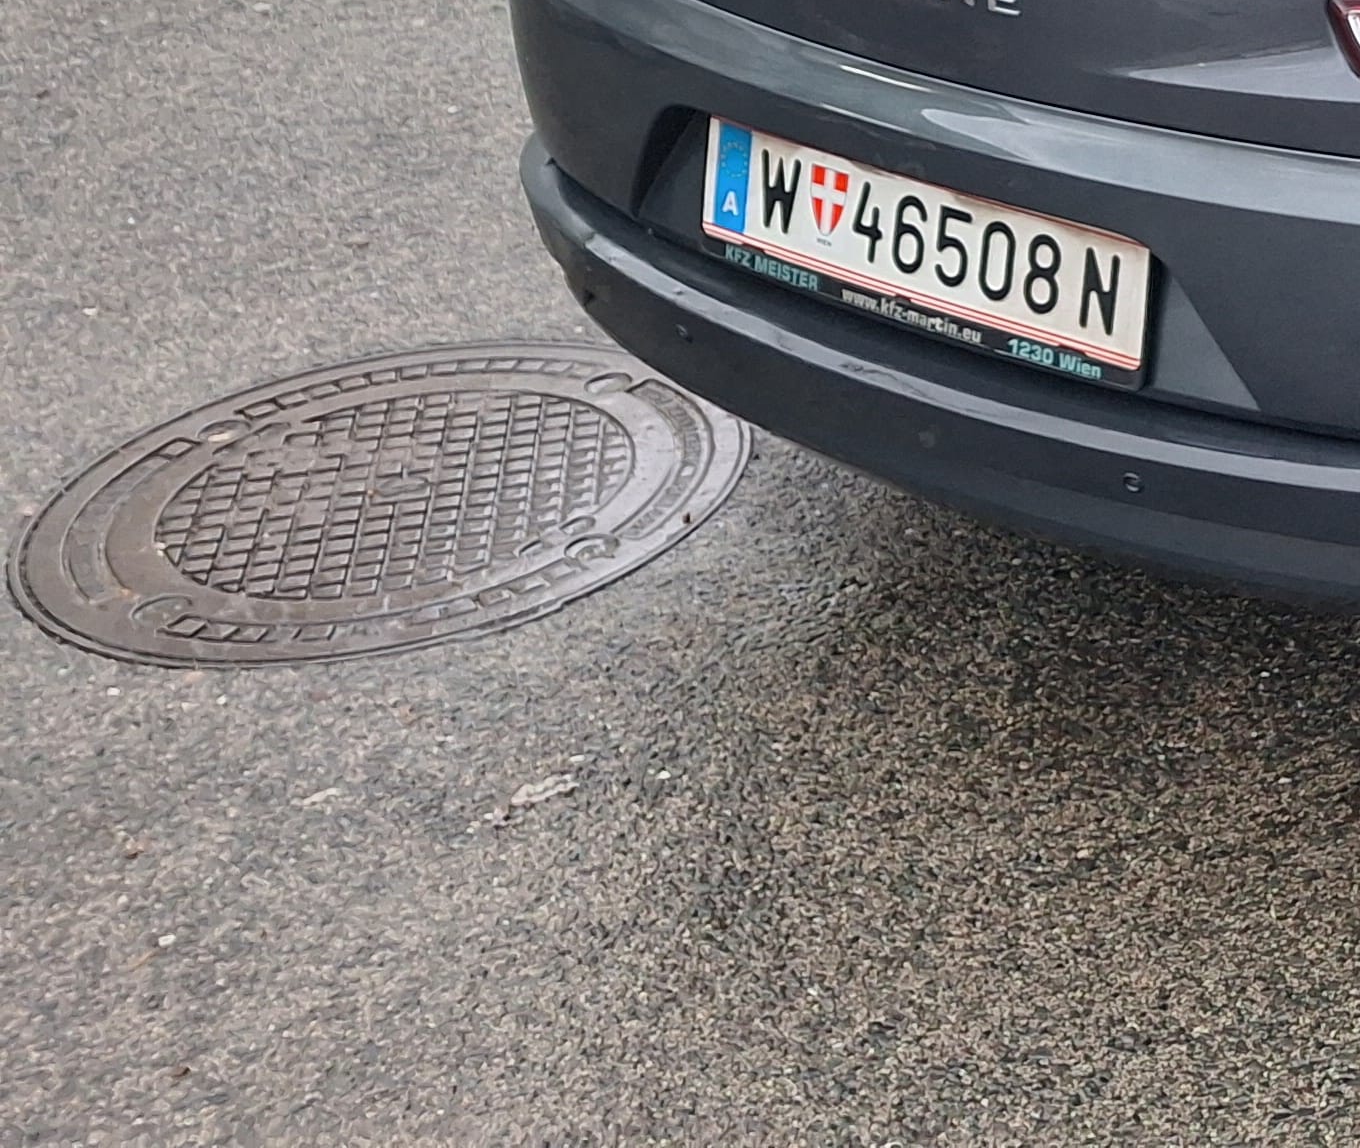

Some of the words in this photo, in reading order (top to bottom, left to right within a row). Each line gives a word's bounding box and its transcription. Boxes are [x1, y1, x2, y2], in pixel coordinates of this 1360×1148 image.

[722, 190, 739, 216] A
[762, 148, 802, 234] W
[725, 243, 754, 266] KFZ
[754, 255, 818, 292] MEISTER
[841, 286, 982, 345] www.kfz-martin.eu
[1007, 337, 1054, 365] 1230
[1059, 351, 1102, 380] Wien
